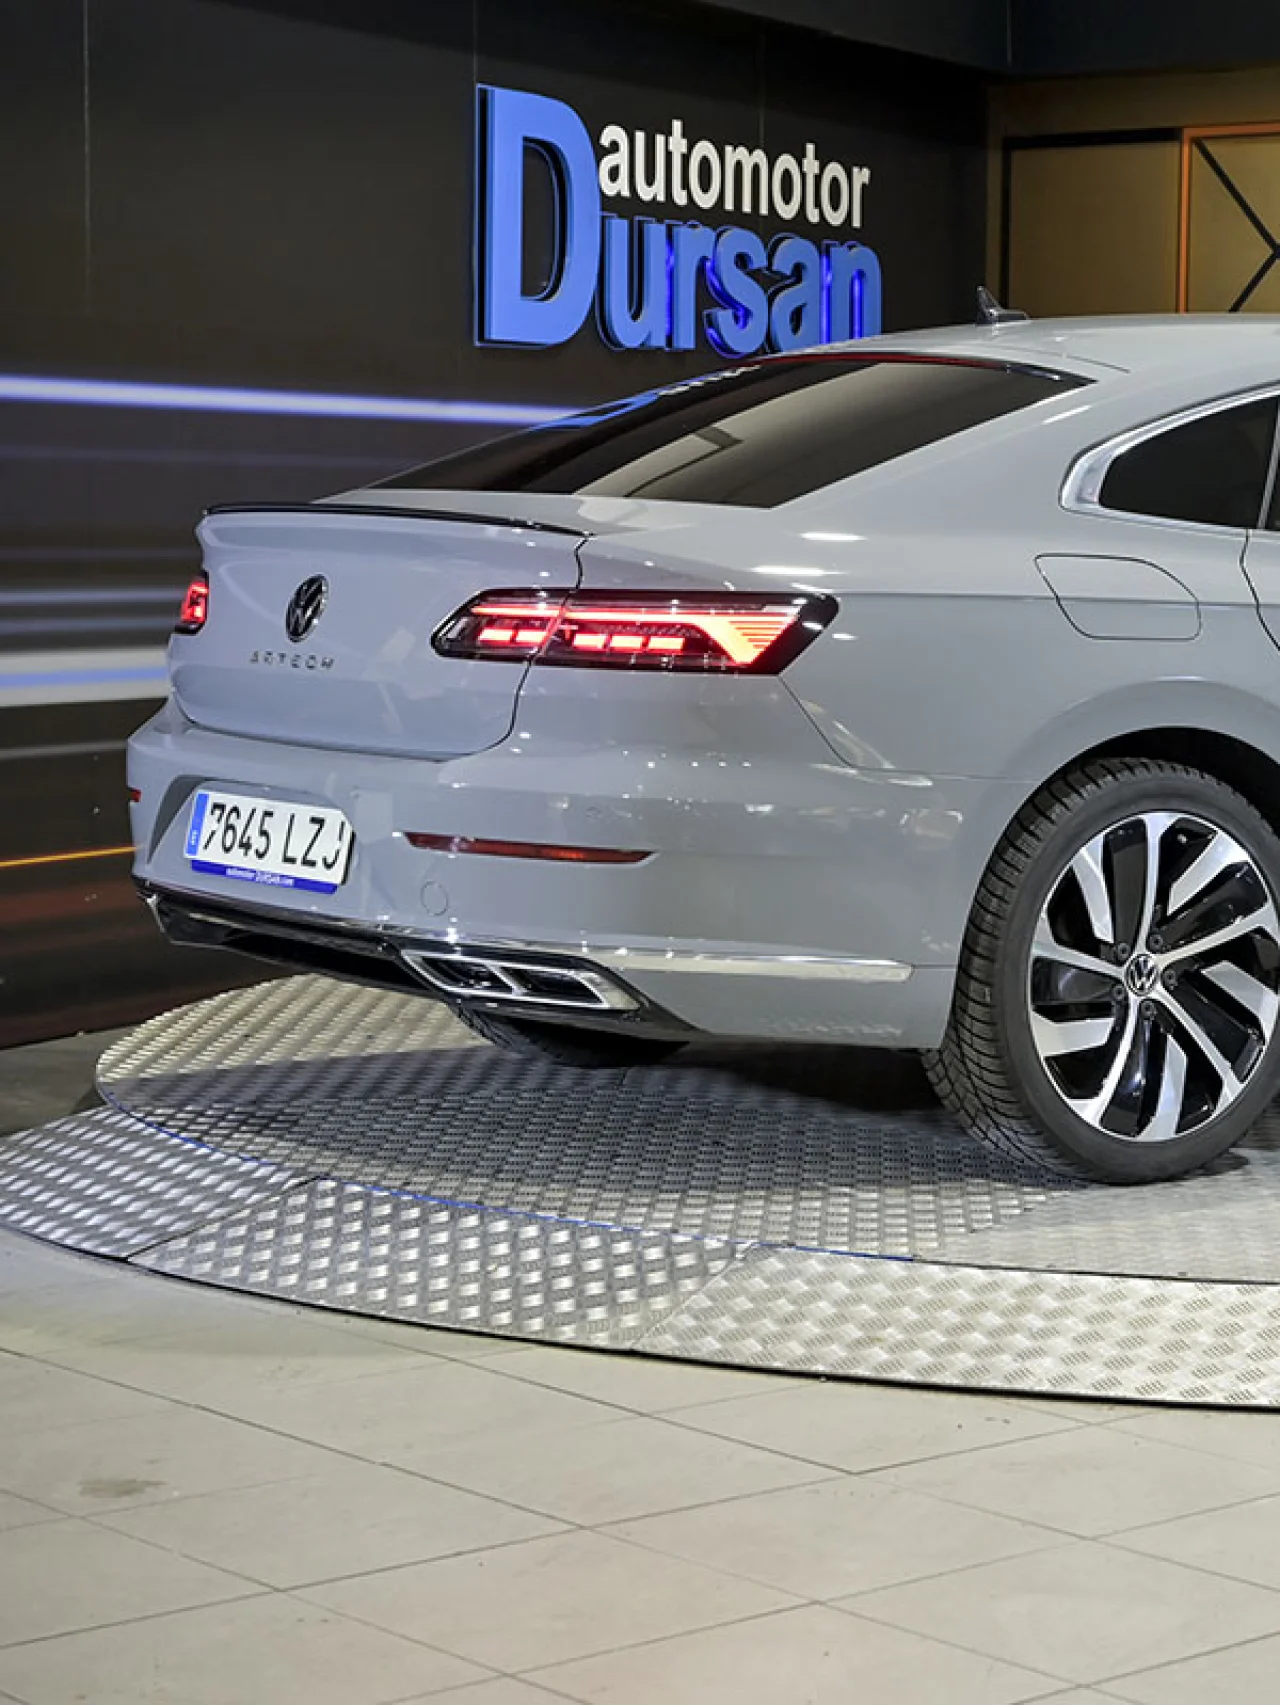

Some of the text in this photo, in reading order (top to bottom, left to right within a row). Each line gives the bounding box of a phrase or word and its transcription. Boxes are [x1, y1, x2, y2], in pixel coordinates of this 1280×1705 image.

[475, 83, 882, 359] Dursan
[598, 119, 871, 229] automotor
[203, 802, 346, 870] 7645 LZJ
